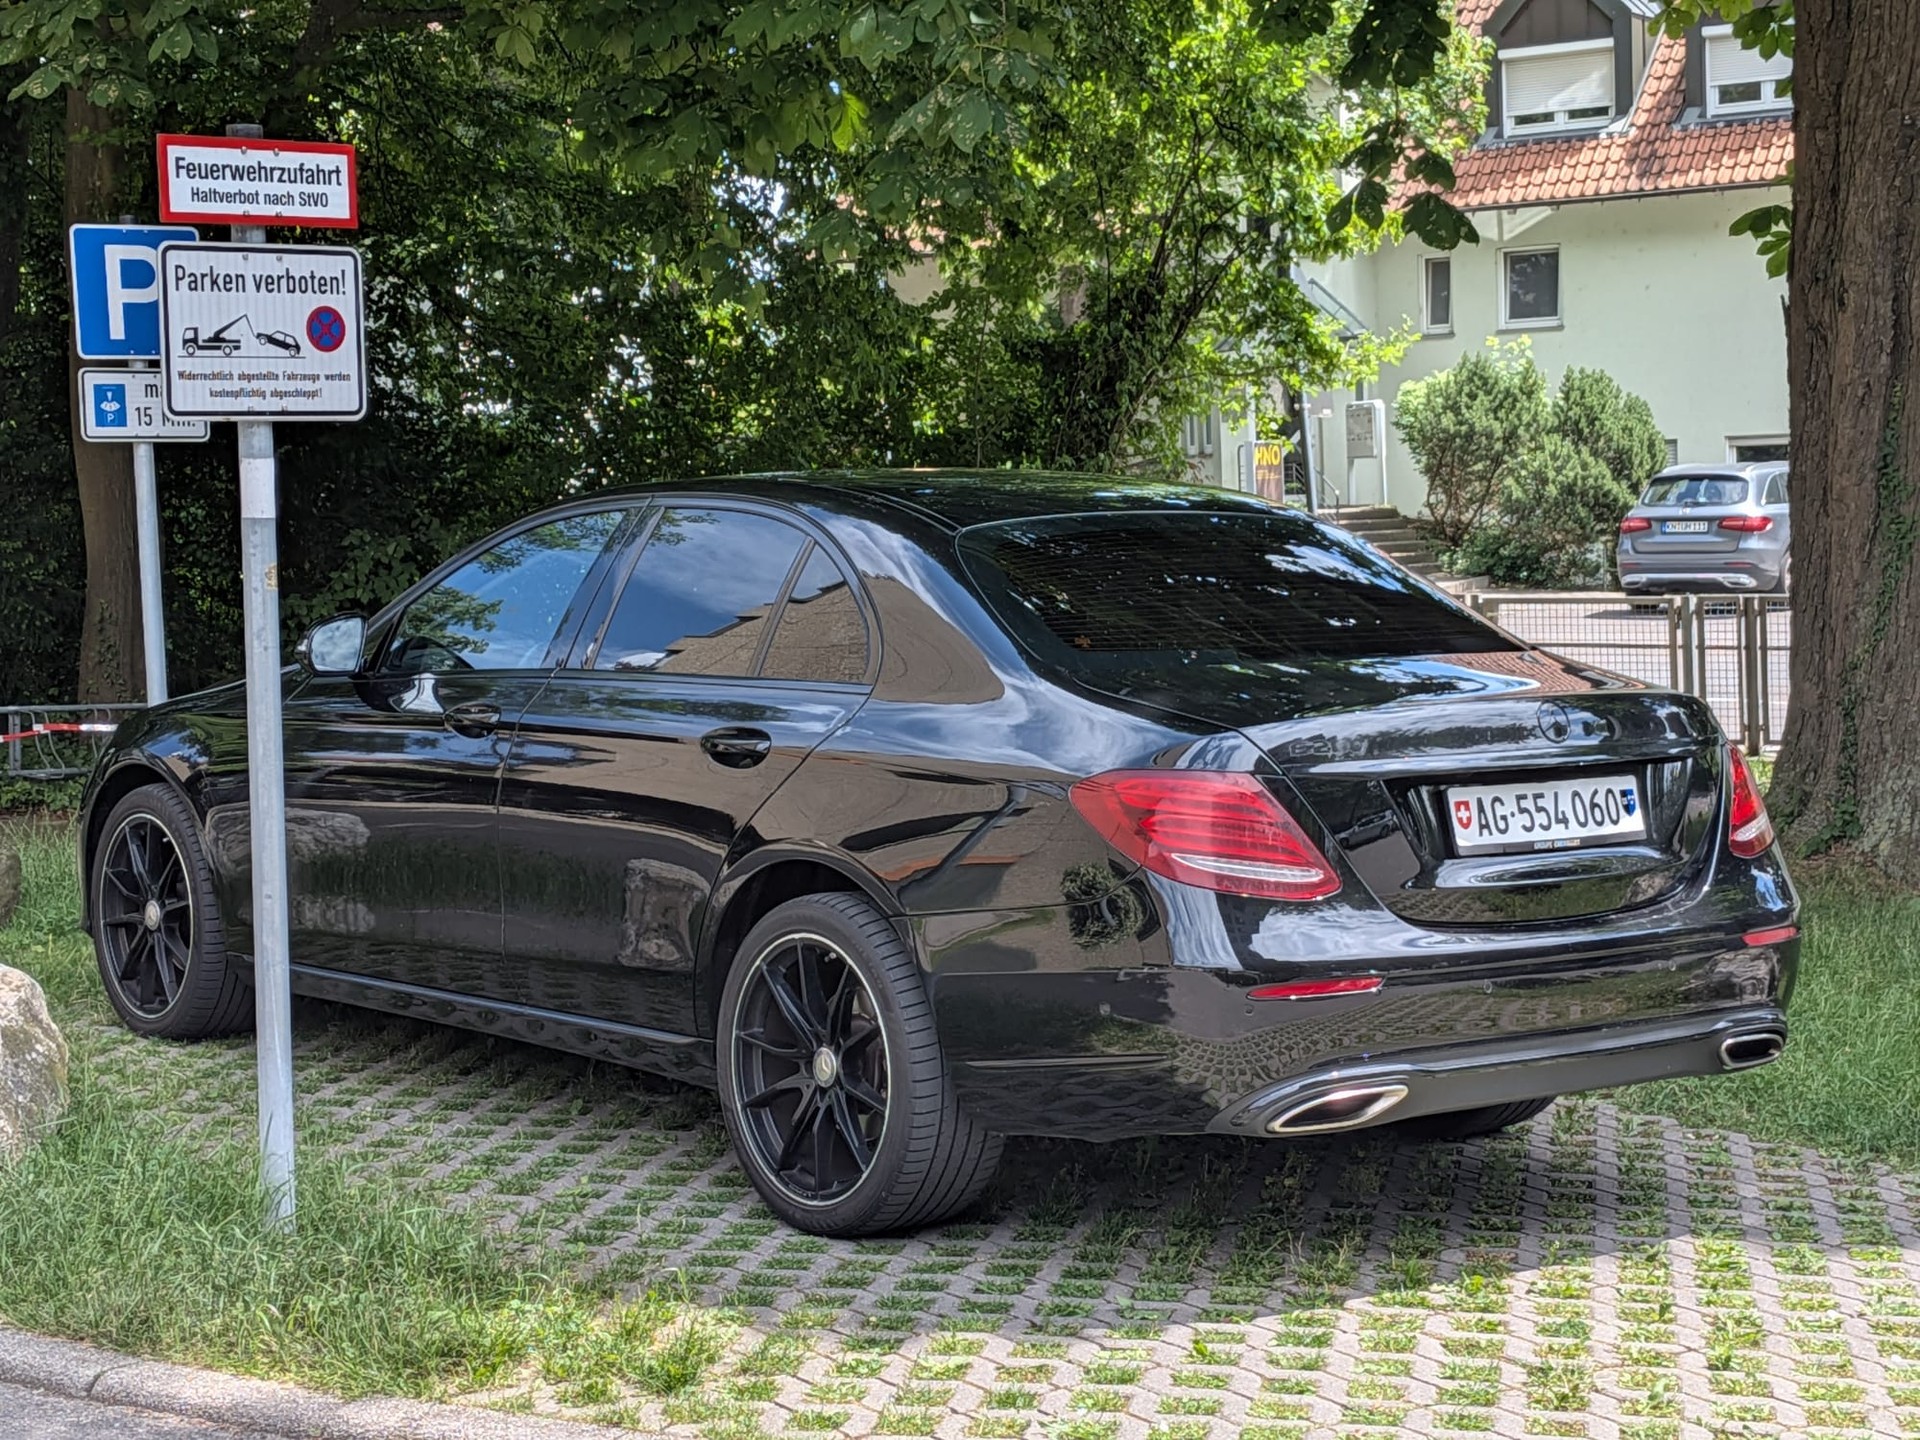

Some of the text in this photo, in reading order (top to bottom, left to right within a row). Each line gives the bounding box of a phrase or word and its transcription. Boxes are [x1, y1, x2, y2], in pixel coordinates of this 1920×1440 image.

[174, 156, 342, 186] Feuerwehrzufahrt
[190, 186, 329, 208] Haltverbot nach StVO
[174, 264, 346, 296] Parken verboten!
[104, 244, 160, 340] P
[177, 370, 351, 384] Widerrechtlich abgestellte Fahrzeuge werden
[209, 387, 322, 401] kostenpflichtig abgeschleppt!
[134, 406, 153, 427] 15
